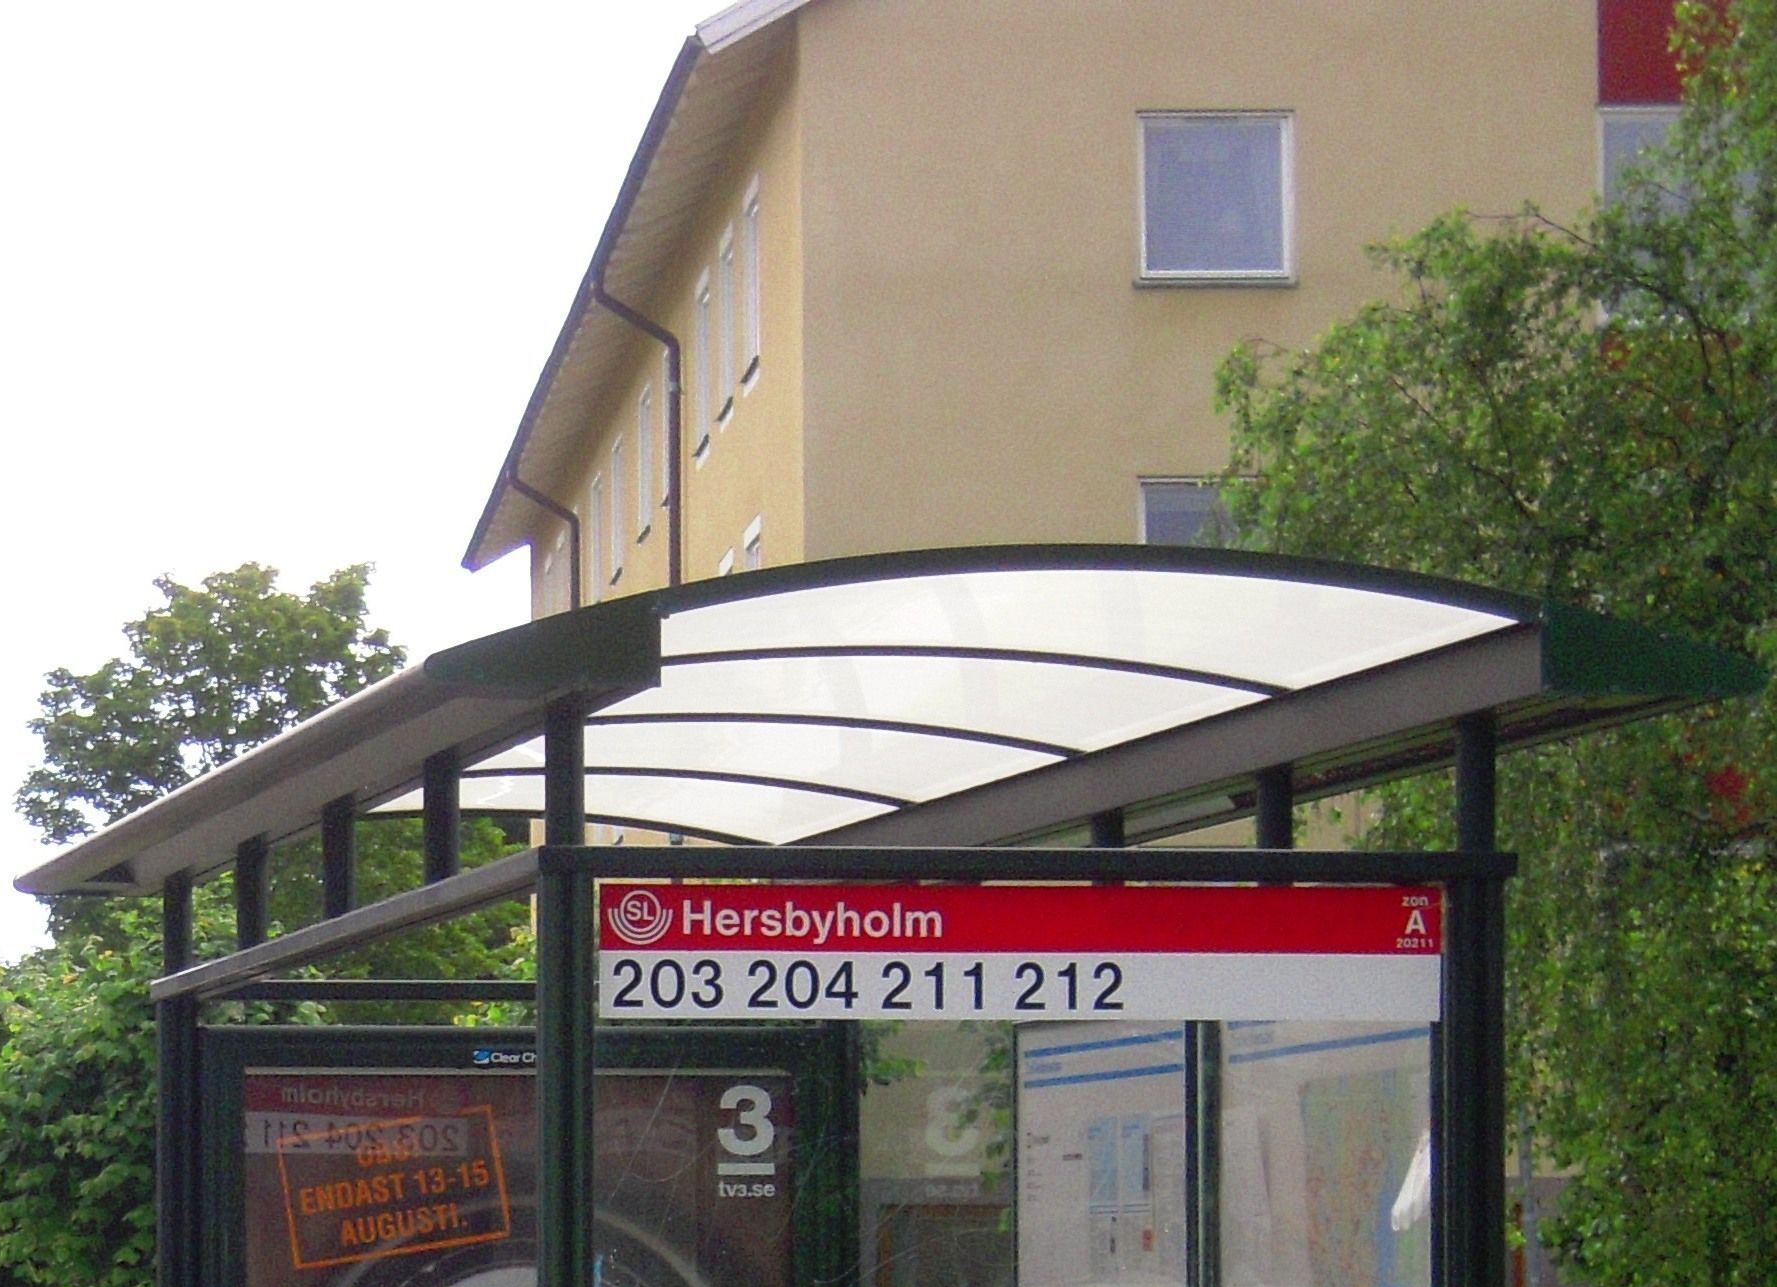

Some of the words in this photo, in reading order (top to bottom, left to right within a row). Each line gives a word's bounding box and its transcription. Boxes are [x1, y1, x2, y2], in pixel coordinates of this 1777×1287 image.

[625, 900, 655, 922] SL
[682, 899, 943, 945] Hersbyholm
[1401, 896, 1429, 907] zon
[1404, 909, 1426, 935] A
[612, 958, 724, 1009] 203
[747, 959, 859, 1010] 204
[881, 960, 984, 1010] 211
[1014, 961, 1124, 1011] 212
[490, 1052, 521, 1063] Clear
[717, 1084, 775, 1156] 3
[298, 1172, 405, 1216] ENDAST
[413, 1159, 490, 1195] 13-15
[718, 1180, 776, 1198] tv3.se
[340, 1202, 468, 1247] AUGUSTI.
